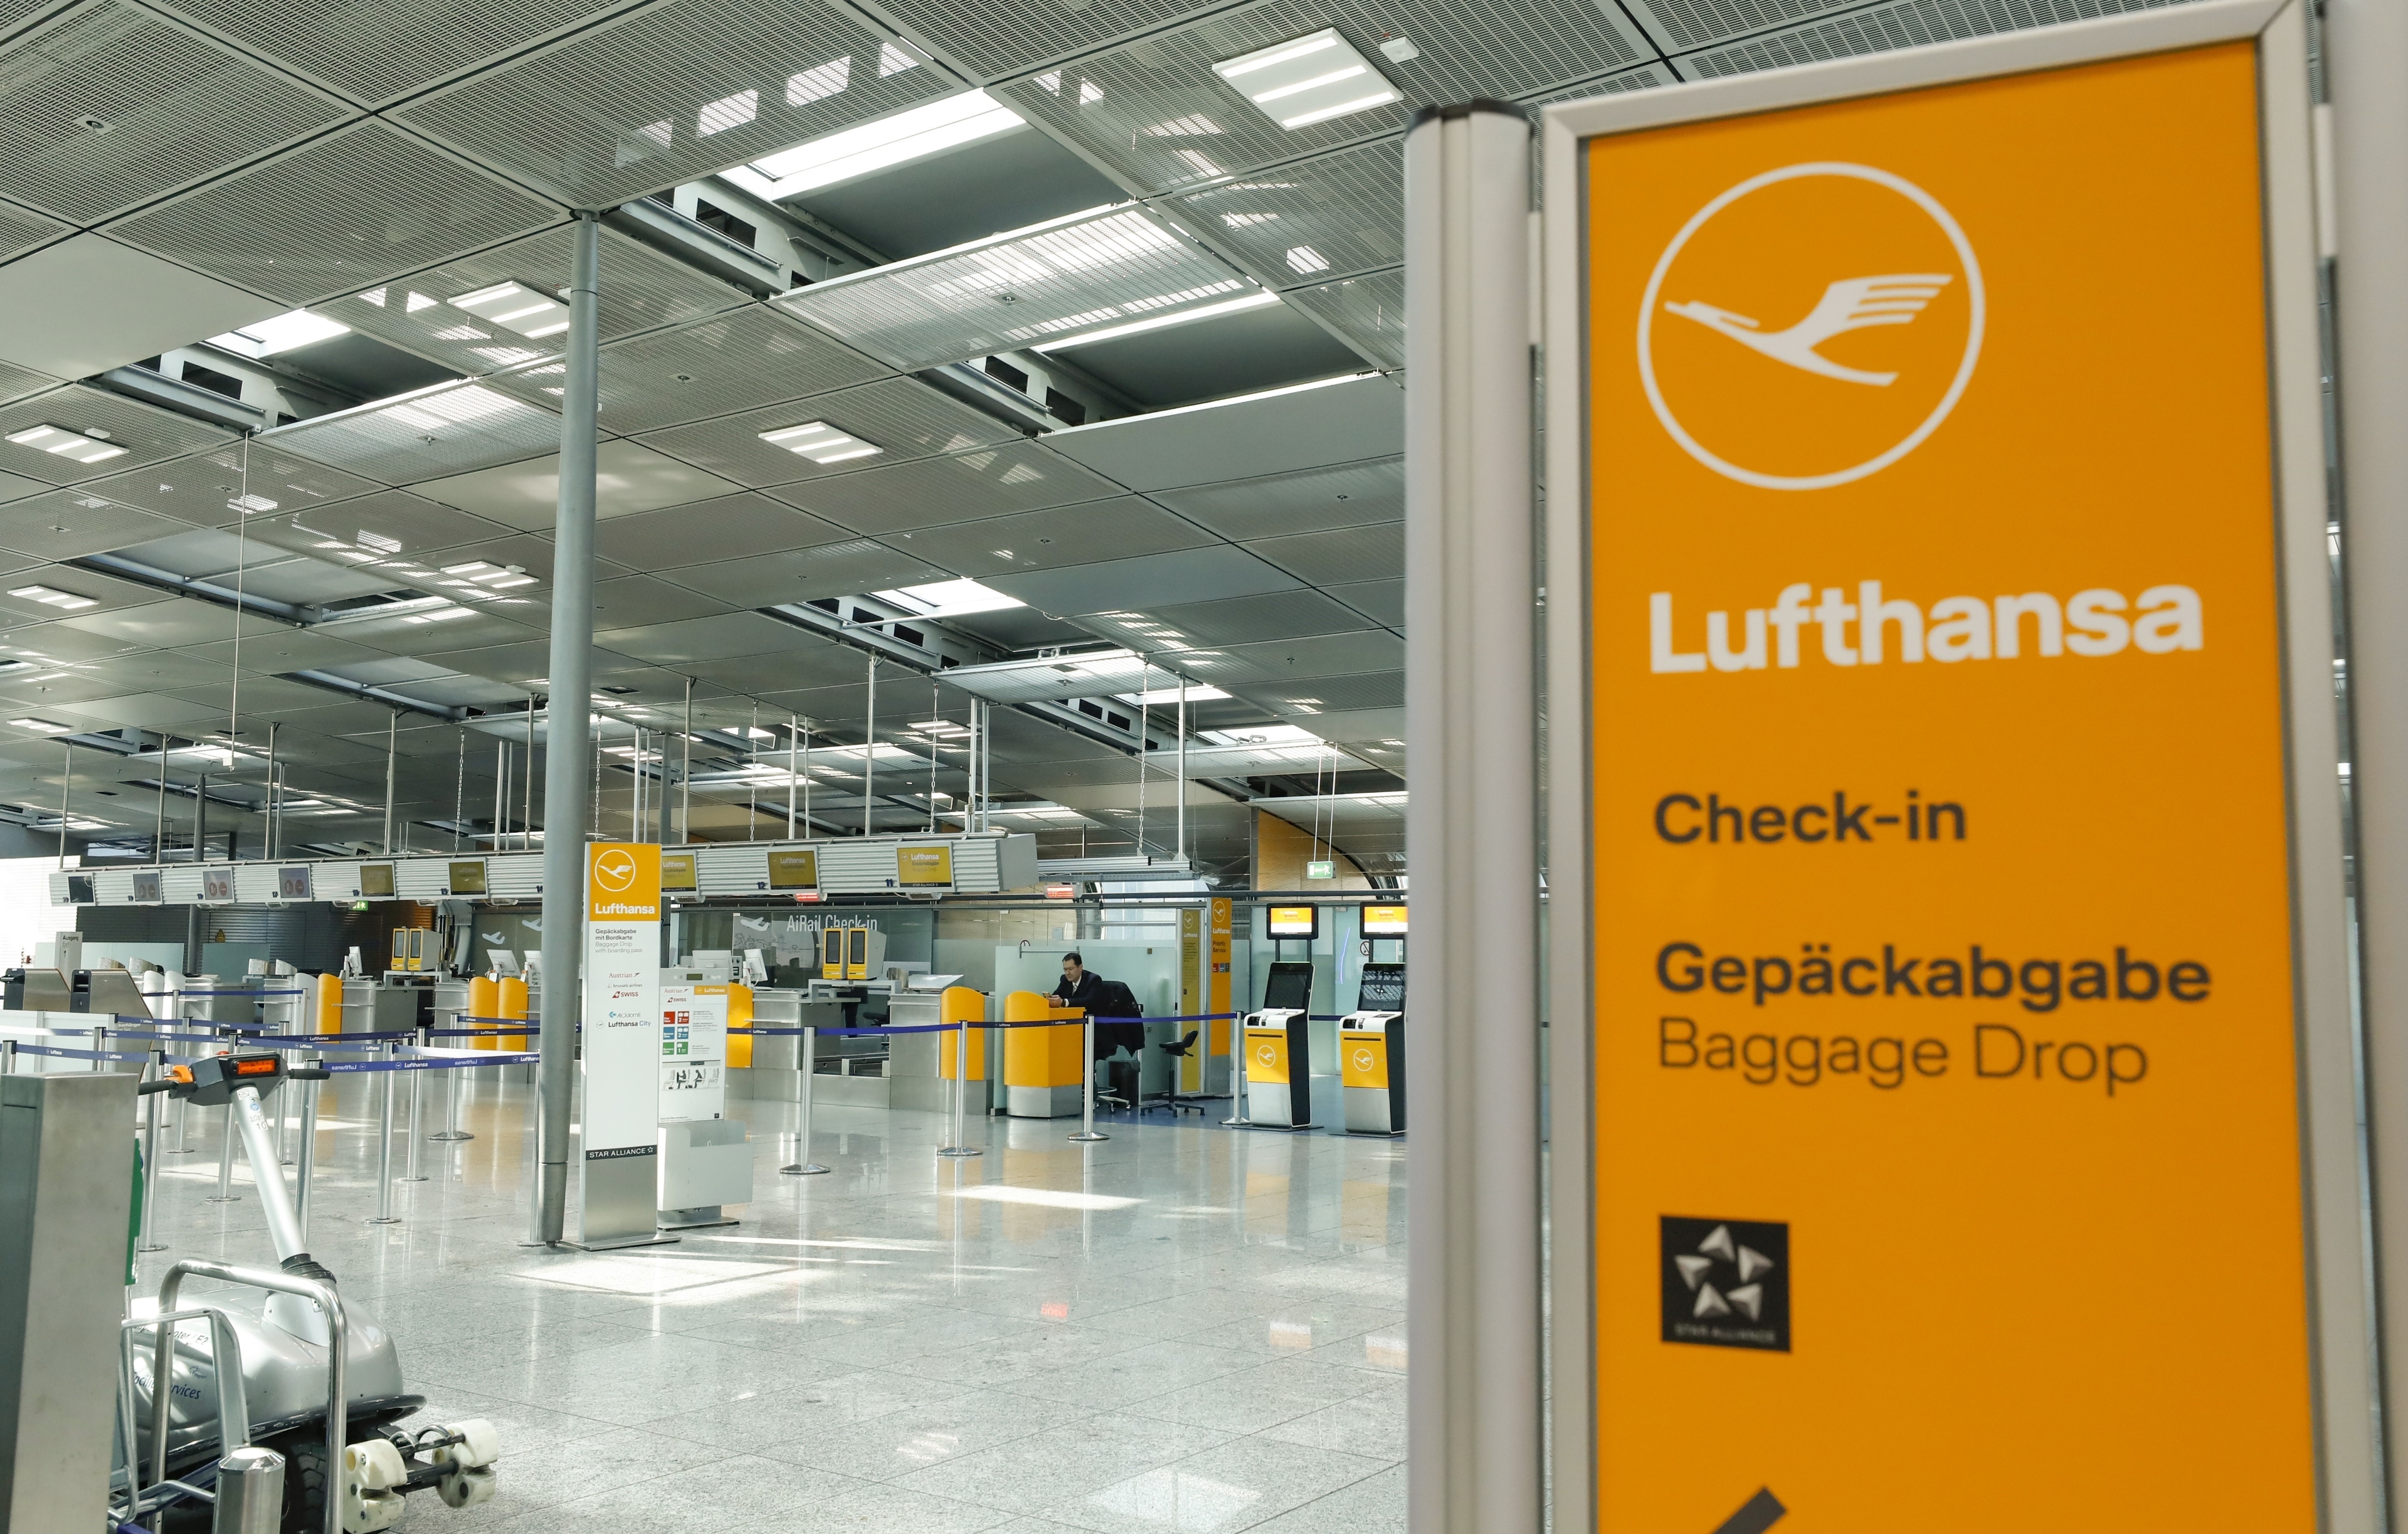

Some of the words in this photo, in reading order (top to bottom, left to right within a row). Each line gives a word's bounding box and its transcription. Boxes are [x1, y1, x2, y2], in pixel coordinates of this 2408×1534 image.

[1650, 580, 2204, 674] Lufthansa
[1654, 788, 1967, 844] Check-in
[756, 881, 766, 889] 12
[885, 879, 893, 887] 11
[595, 903, 655, 914] Lufthansa
[786, 914, 821, 932] AiRail
[825, 914, 877, 931] Check-in
[1656, 941, 2212, 1013] Gepäckabgabe
[1659, 1016, 1950, 1090] Baggage
[1973, 1022, 2148, 1098] Drop
[611, 1148, 646, 1156] ALLIANCE
[171, 1383, 201, 1399] rvices
